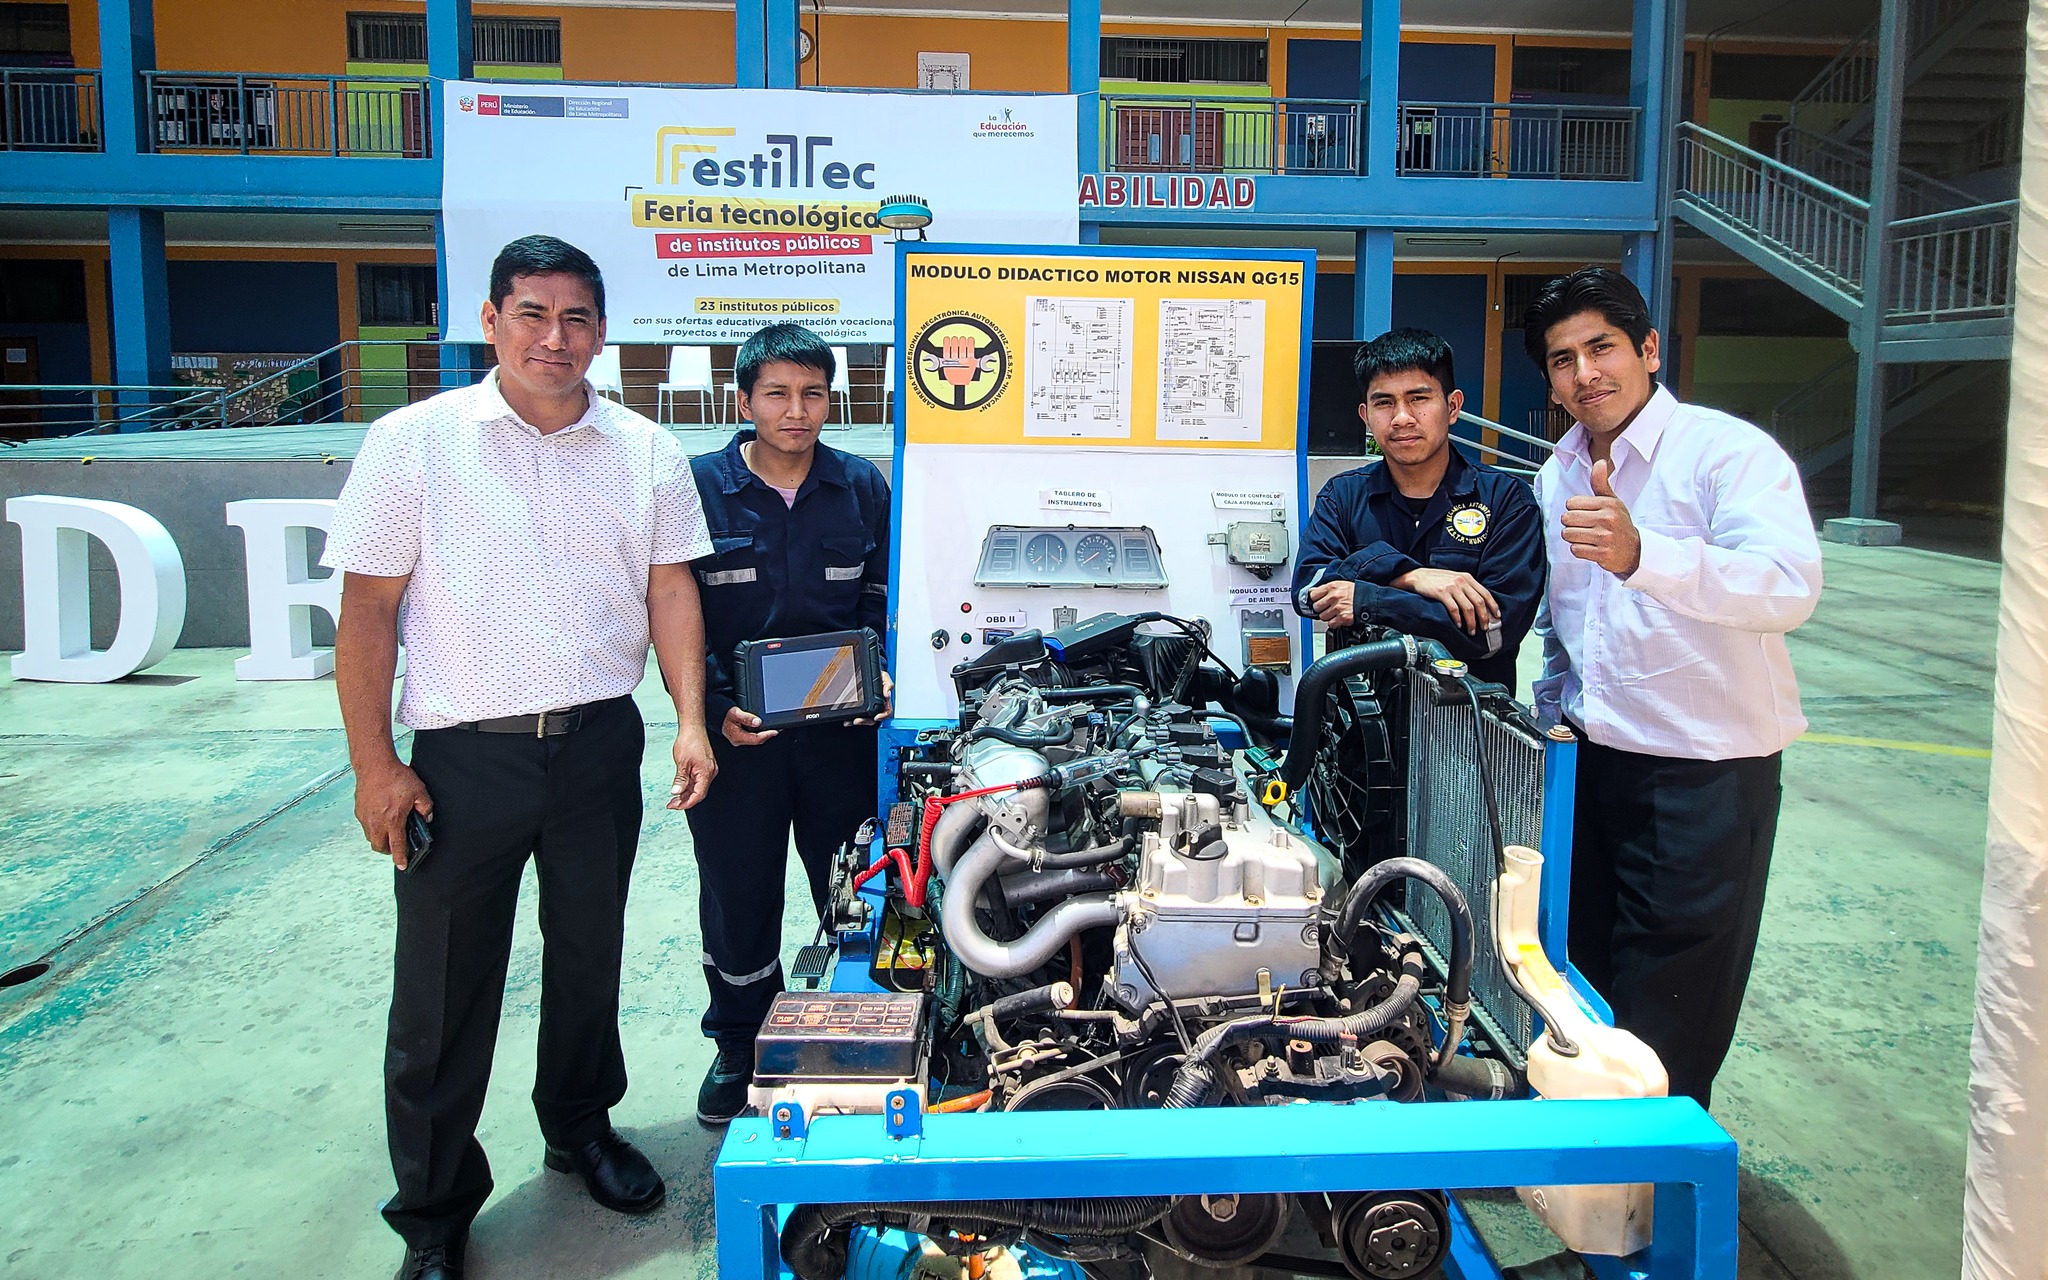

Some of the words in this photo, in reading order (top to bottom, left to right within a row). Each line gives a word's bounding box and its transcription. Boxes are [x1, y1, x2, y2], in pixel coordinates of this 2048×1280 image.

[480, 100, 498, 109] PERÚ
[980, 121, 1027, 131] Educación
[987, 130, 1035, 138] merecemos
[644, 199, 713, 223] Feria
[720, 203, 880, 232] tecnológica
[669, 239, 693, 253] de
[697, 238, 781, 252] institutos
[786, 236, 861, 255] públicos
[667, 263, 690, 278] de
[696, 263, 738, 278] Lima
[744, 261, 867, 279] Metropolitana
[911, 265, 991, 279] MODULO
[998, 267, 1099, 282] DIDACTICO
[1105, 270, 1172, 283] MOTOR
[1178, 270, 1245, 284] NISSAN
[1252, 272, 1300, 286] QG15
[700, 302, 715, 311] 23
[720, 301, 778, 312] institutos
[781, 300, 835, 314] públicos
[676, 316, 714, 326] ofertas
[663, 328, 718, 339] proyectos
[911, 380, 936, 410] CARRERA
[971, 312, 1009, 346] AUTOMOTRIZ
[1054, 490, 1086, 498] TABLERO
[1048, 500, 1102, 508] INSTRUMENTOS
